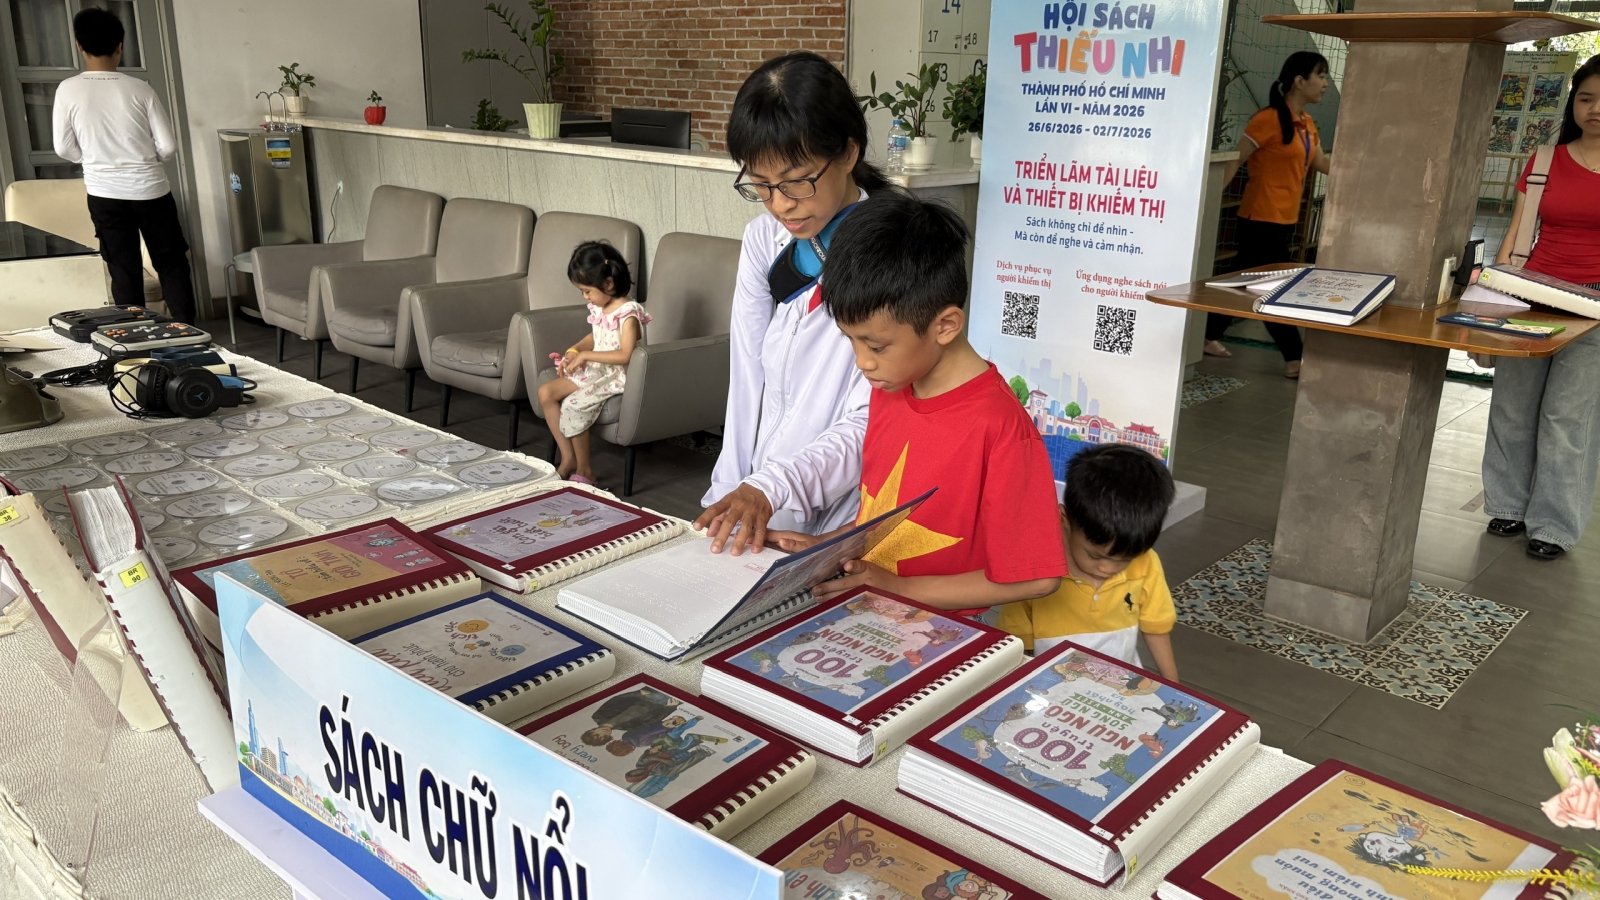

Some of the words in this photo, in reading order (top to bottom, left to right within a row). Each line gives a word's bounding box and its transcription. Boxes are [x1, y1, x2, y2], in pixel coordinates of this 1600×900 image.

[1043, 0, 1087, 32] HỘI
[1092, 0, 1156, 30] SÁCH
[928, 30, 938, 43] 17
[967, 33, 977, 45] 18
[1014, 29, 1116, 74] THIẾU
[1122, 36, 1186, 78] NHI
[1021, 81, 1060, 96] THÀNH
[1062, 80, 1086, 97] PHỐ
[1089, 81, 1106, 98] HỒ
[1109, 83, 1130, 98] CHÍ
[1131, 86, 1165, 100] MINH
[1035, 97, 1058, 114] LẦN
[1061, 102, 1072, 114] VI
[1082, 101, 1110, 116] NĂM
[1113, 105, 1145, 117] 2026
[1028, 122, 1082, 134] 26/6/2026
[1093, 125, 1151, 139] 02/7/2026
[1015, 153, 1057, 181] TRIỂN
[1060, 160, 1091, 184] LÃM
[1096, 162, 1120, 187] TÀI
[1123, 165, 1158, 194] LIỆU
[1003, 183, 1022, 204] VÀ
[1026, 182, 1066, 209] THIẾT
[1069, 192, 1083, 216] BỊ
[1086, 187, 1135, 216] KHIẾM
[1139, 198, 1166, 223] THỊ
[1026, 216, 1046, 228] Sách
[1048, 218, 1075, 233] không
[1077, 220, 1091, 233] chỉ
[1093, 220, 1104, 234] để
[1106, 222, 1127, 236] nhìn
[1014, 231, 1027, 241] Mà
[1029, 232, 1044, 243] còn
[1046, 232, 1058, 245] để
[1059, 237, 1081, 249] nghe
[1082, 237, 1093, 249] và
[1095, 238, 1115, 251] cảm
[1117, 242, 1144, 255] nhận.
[996, 260, 1013, 272] Dịch
[1014, 264, 1022, 273] vụ
[1024, 263, 1042, 275] phục
[1043, 267, 1052, 276] vụ
[996, 272, 1016, 285] người
[1017, 273, 1040, 287] khiếm
[1041, 278, 1051, 289] thị
[1075, 269, 1091, 284] Ứng
[1093, 273, 1112, 285] dụng
[1113, 277, 1133, 288] nghe
[1134, 277, 1151, 289] sách
[1081, 284, 1094, 294] cho
[1096, 286, 1118, 299] người
[1119, 287, 1144, 301] khiếm
[3, 515, 13, 523] 38
[512, 533, 537, 545] Con
[311, 549, 343, 566] TÍNH
[127, 567, 139, 576] BR
[131, 574, 141, 584] 90
[817, 628, 865, 650] NGÔN
[867, 635, 898, 650] SONG
[402, 643, 430, 663] phúc
[423, 649, 449, 670] hạnh
[820, 644, 863, 664] truyện
[859, 644, 899, 663] NGỤ
[444, 662, 466, 678] cho
[794, 649, 858, 679] 100
[1060, 698, 1091, 715] NGỮ
[1076, 695, 1100, 709] VIỆT
[1085, 690, 1114, 704] nhất
[1110, 692, 1127, 702] 3/3
[1041, 705, 1091, 730] NGÔ
[1106, 707, 1129, 721] ANH
[1111, 701, 1136, 715] hay
[1090, 711, 1129, 731] SONG
[551, 734, 572, 750] boy
[1041, 722, 1095, 750] truyện
[1086, 723, 1136, 751] NGỤ
[569, 744, 598, 763] every
[1013, 728, 1092, 770] 100
[319, 695, 410, 844] SÁCH
[419, 774, 498, 900] CHỮ
[1292, 854, 1320, 870] vui
[1321, 867, 1363, 889] niềm
[1297, 880, 1335, 900] điều
[1318, 877, 1364, 900] mong
